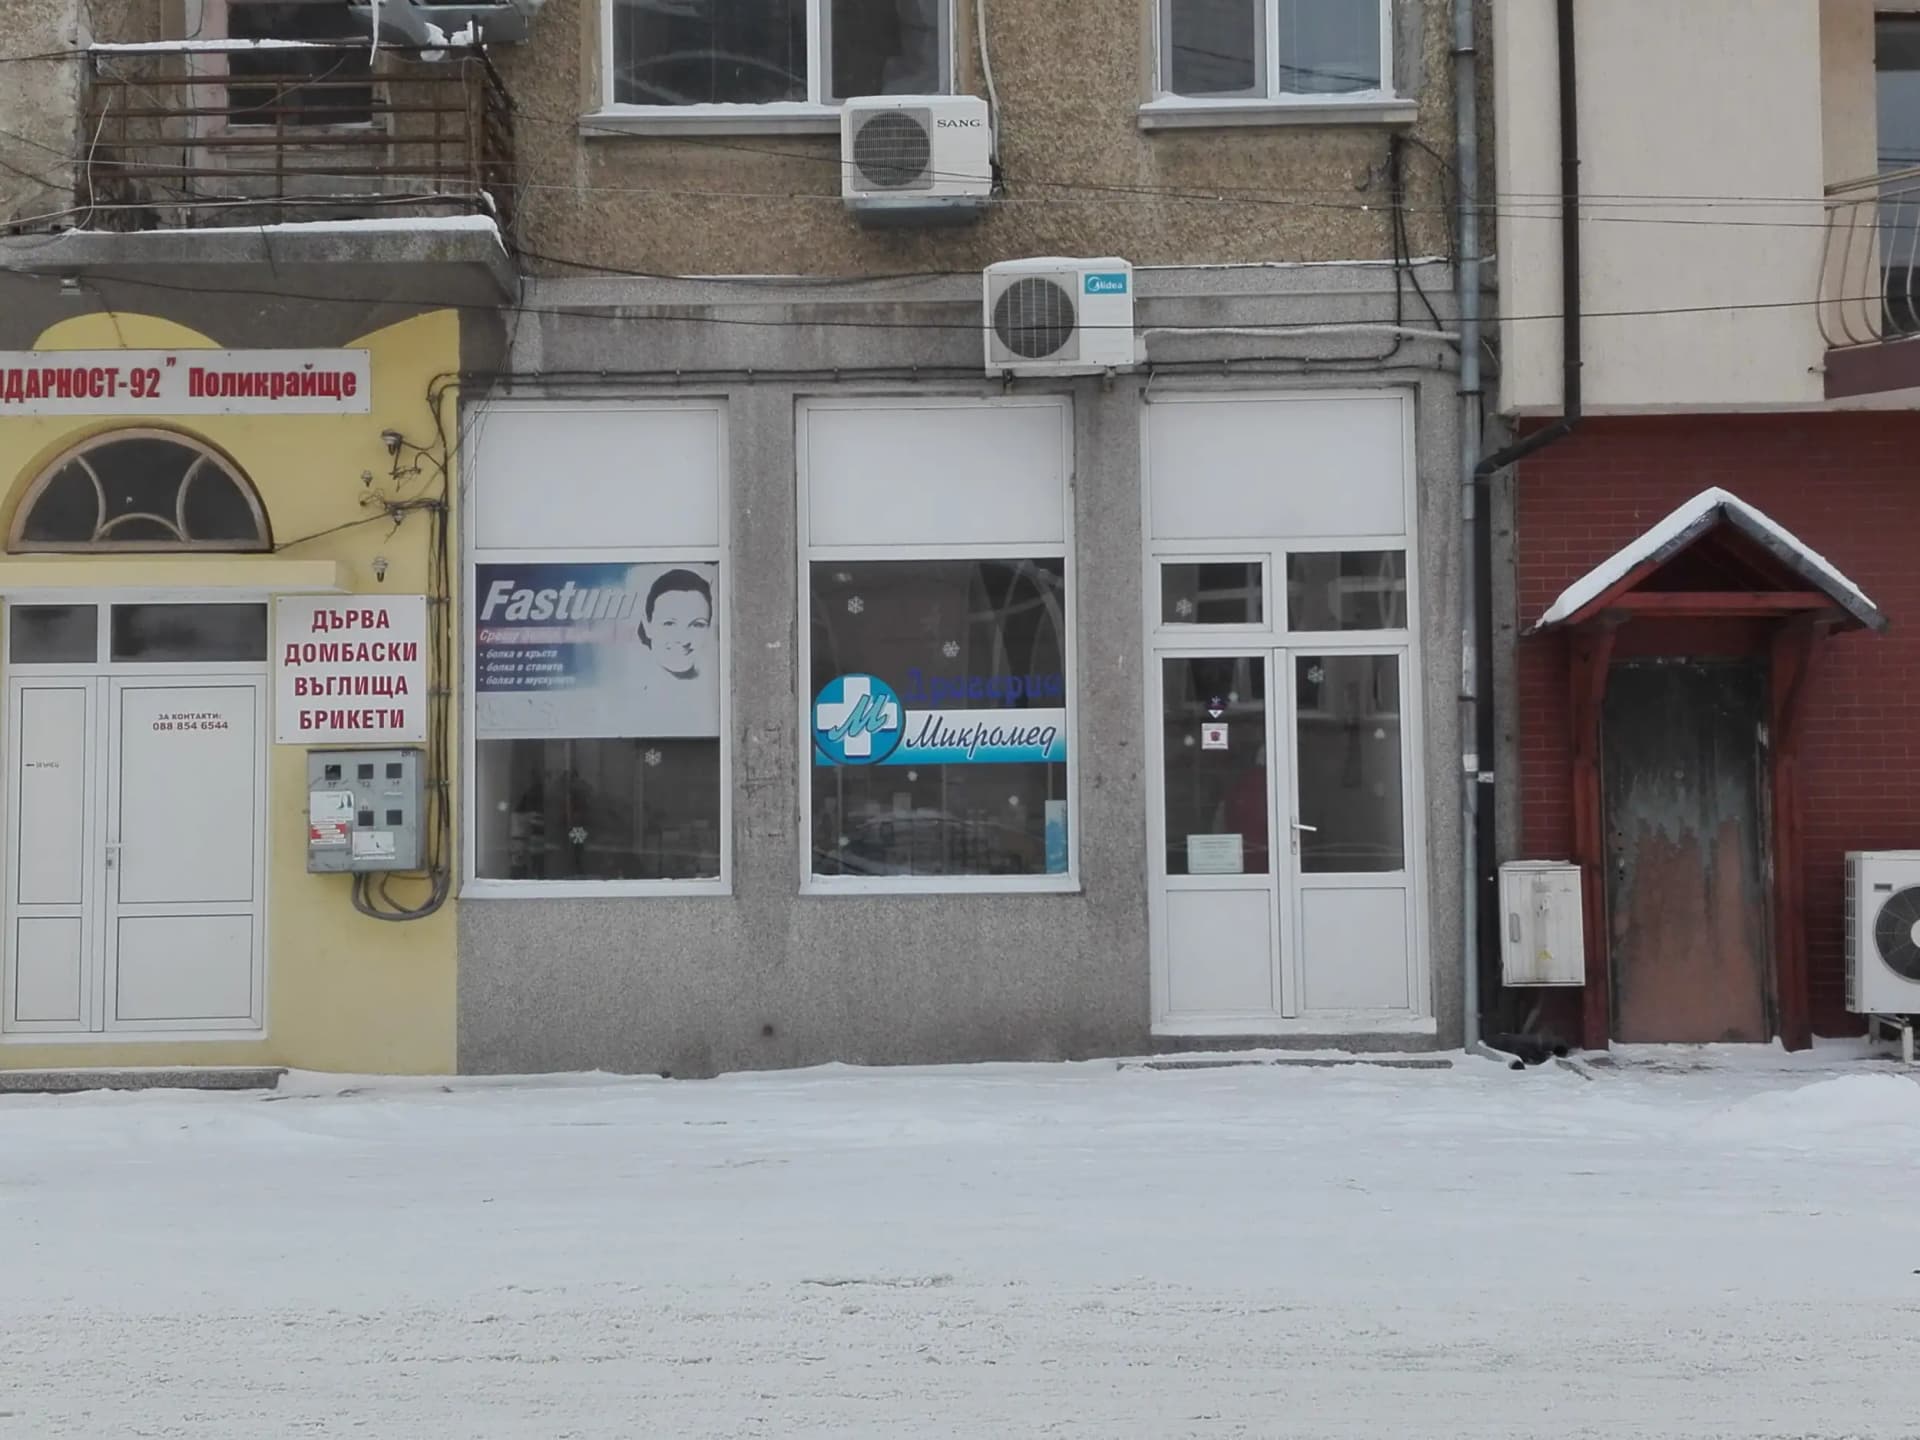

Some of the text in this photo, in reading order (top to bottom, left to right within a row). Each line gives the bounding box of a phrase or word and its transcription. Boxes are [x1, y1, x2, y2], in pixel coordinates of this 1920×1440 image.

[1088, 278, 1123, 290] Midea
[0, 357, 357, 403] ДАРНОСТ-92" Поликрайще
[480, 580, 638, 621] Fastum
[311, 609, 390, 633] ДЪРВА
[284, 642, 417, 666] ДОМБАСКИ
[294, 675, 408, 698] ВЪГЛИЩА
[152, 721, 229, 731] 088 854 6544
[299, 709, 404, 729] БРИКЕТИ
[906, 714, 1057, 758] Микромед
